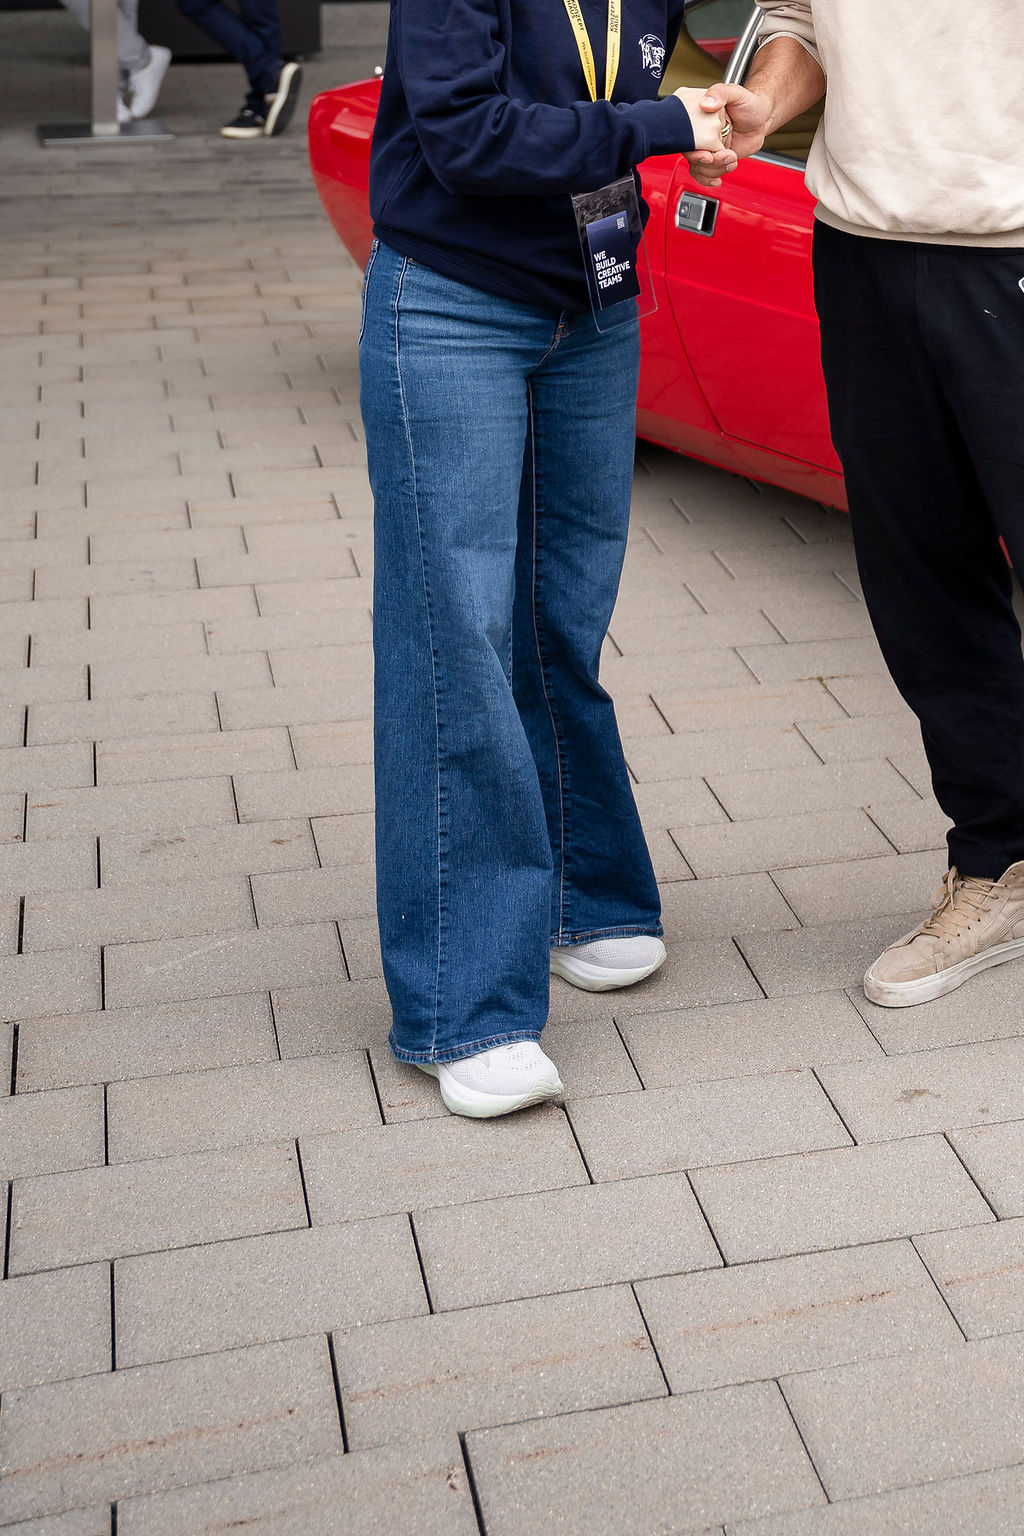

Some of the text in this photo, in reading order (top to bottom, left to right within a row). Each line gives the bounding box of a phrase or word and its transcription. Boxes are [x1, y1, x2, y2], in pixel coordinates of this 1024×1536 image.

[566, 0, 576, 19] HAUS
[571, 0, 585, 31] KONZEPT
[594, 251, 606, 262] WE
[595, 257, 616, 271] BUILD
[597, 261, 630, 279] CREATIVE
[599, 273, 622, 289] TEAMS
